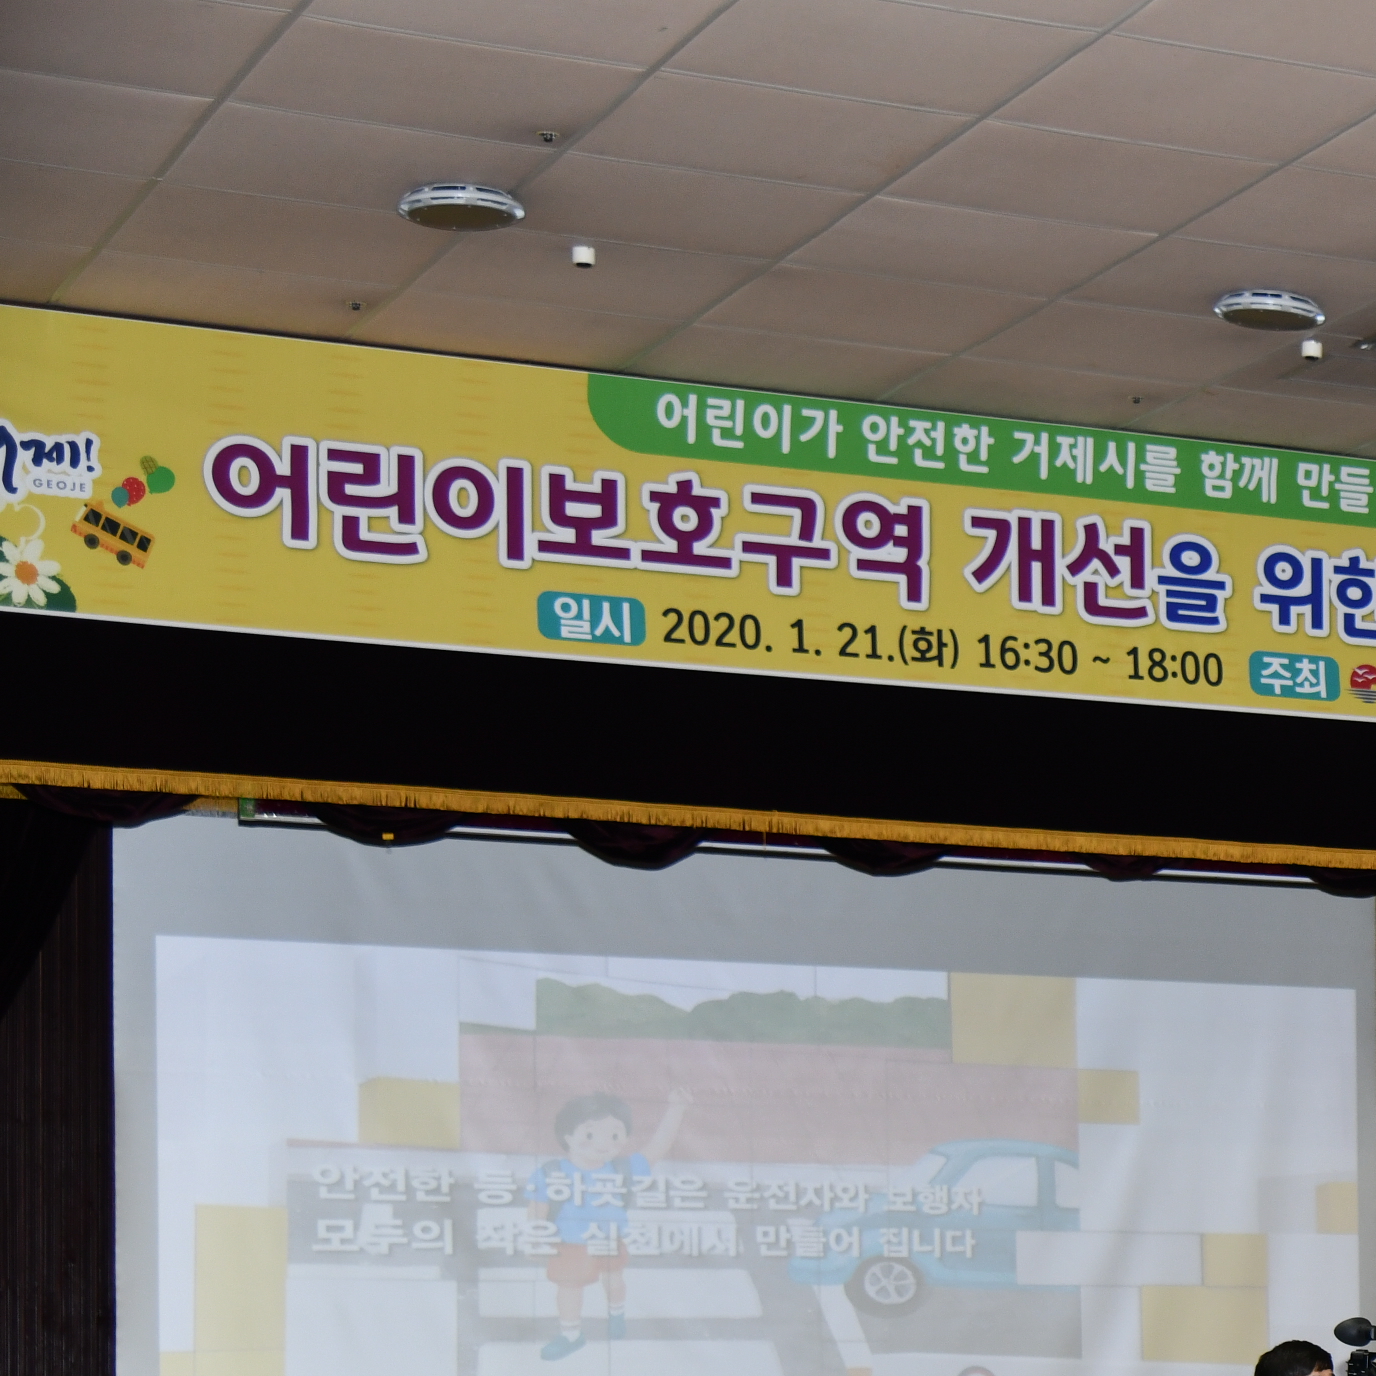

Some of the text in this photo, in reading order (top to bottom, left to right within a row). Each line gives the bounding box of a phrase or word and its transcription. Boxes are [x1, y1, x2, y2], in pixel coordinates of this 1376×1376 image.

[656, 392, 843, 459] 어린이가
[862, 414, 995, 473] 안전한
[1011, 432, 1182, 495] 거제시를
[1200, 451, 1278, 504] 함께
[33, 478, 86, 492] GEOJE
[211, 441, 926, 604] 어린이보호구역
[965, 514, 1227, 626] 개선을
[553, 597, 632, 643] 일시
[662, 609, 773, 653] 2020.
[790, 619, 822, 656] 1.
[838, 623, 959, 669] 21.(화)
[977, 634, 1079, 676] 16:30
[1126, 645, 1223, 687] 18:00
[1259, 656, 1327, 699] 주최
[312, 1162, 455, 1202] 안전한
[722, 1179, 870, 1214] 운전자와
[887, 1183, 983, 1216] 보행자
[312, 1217, 977, 1259] 모두의 작은 실천에서 만들어 집니다
